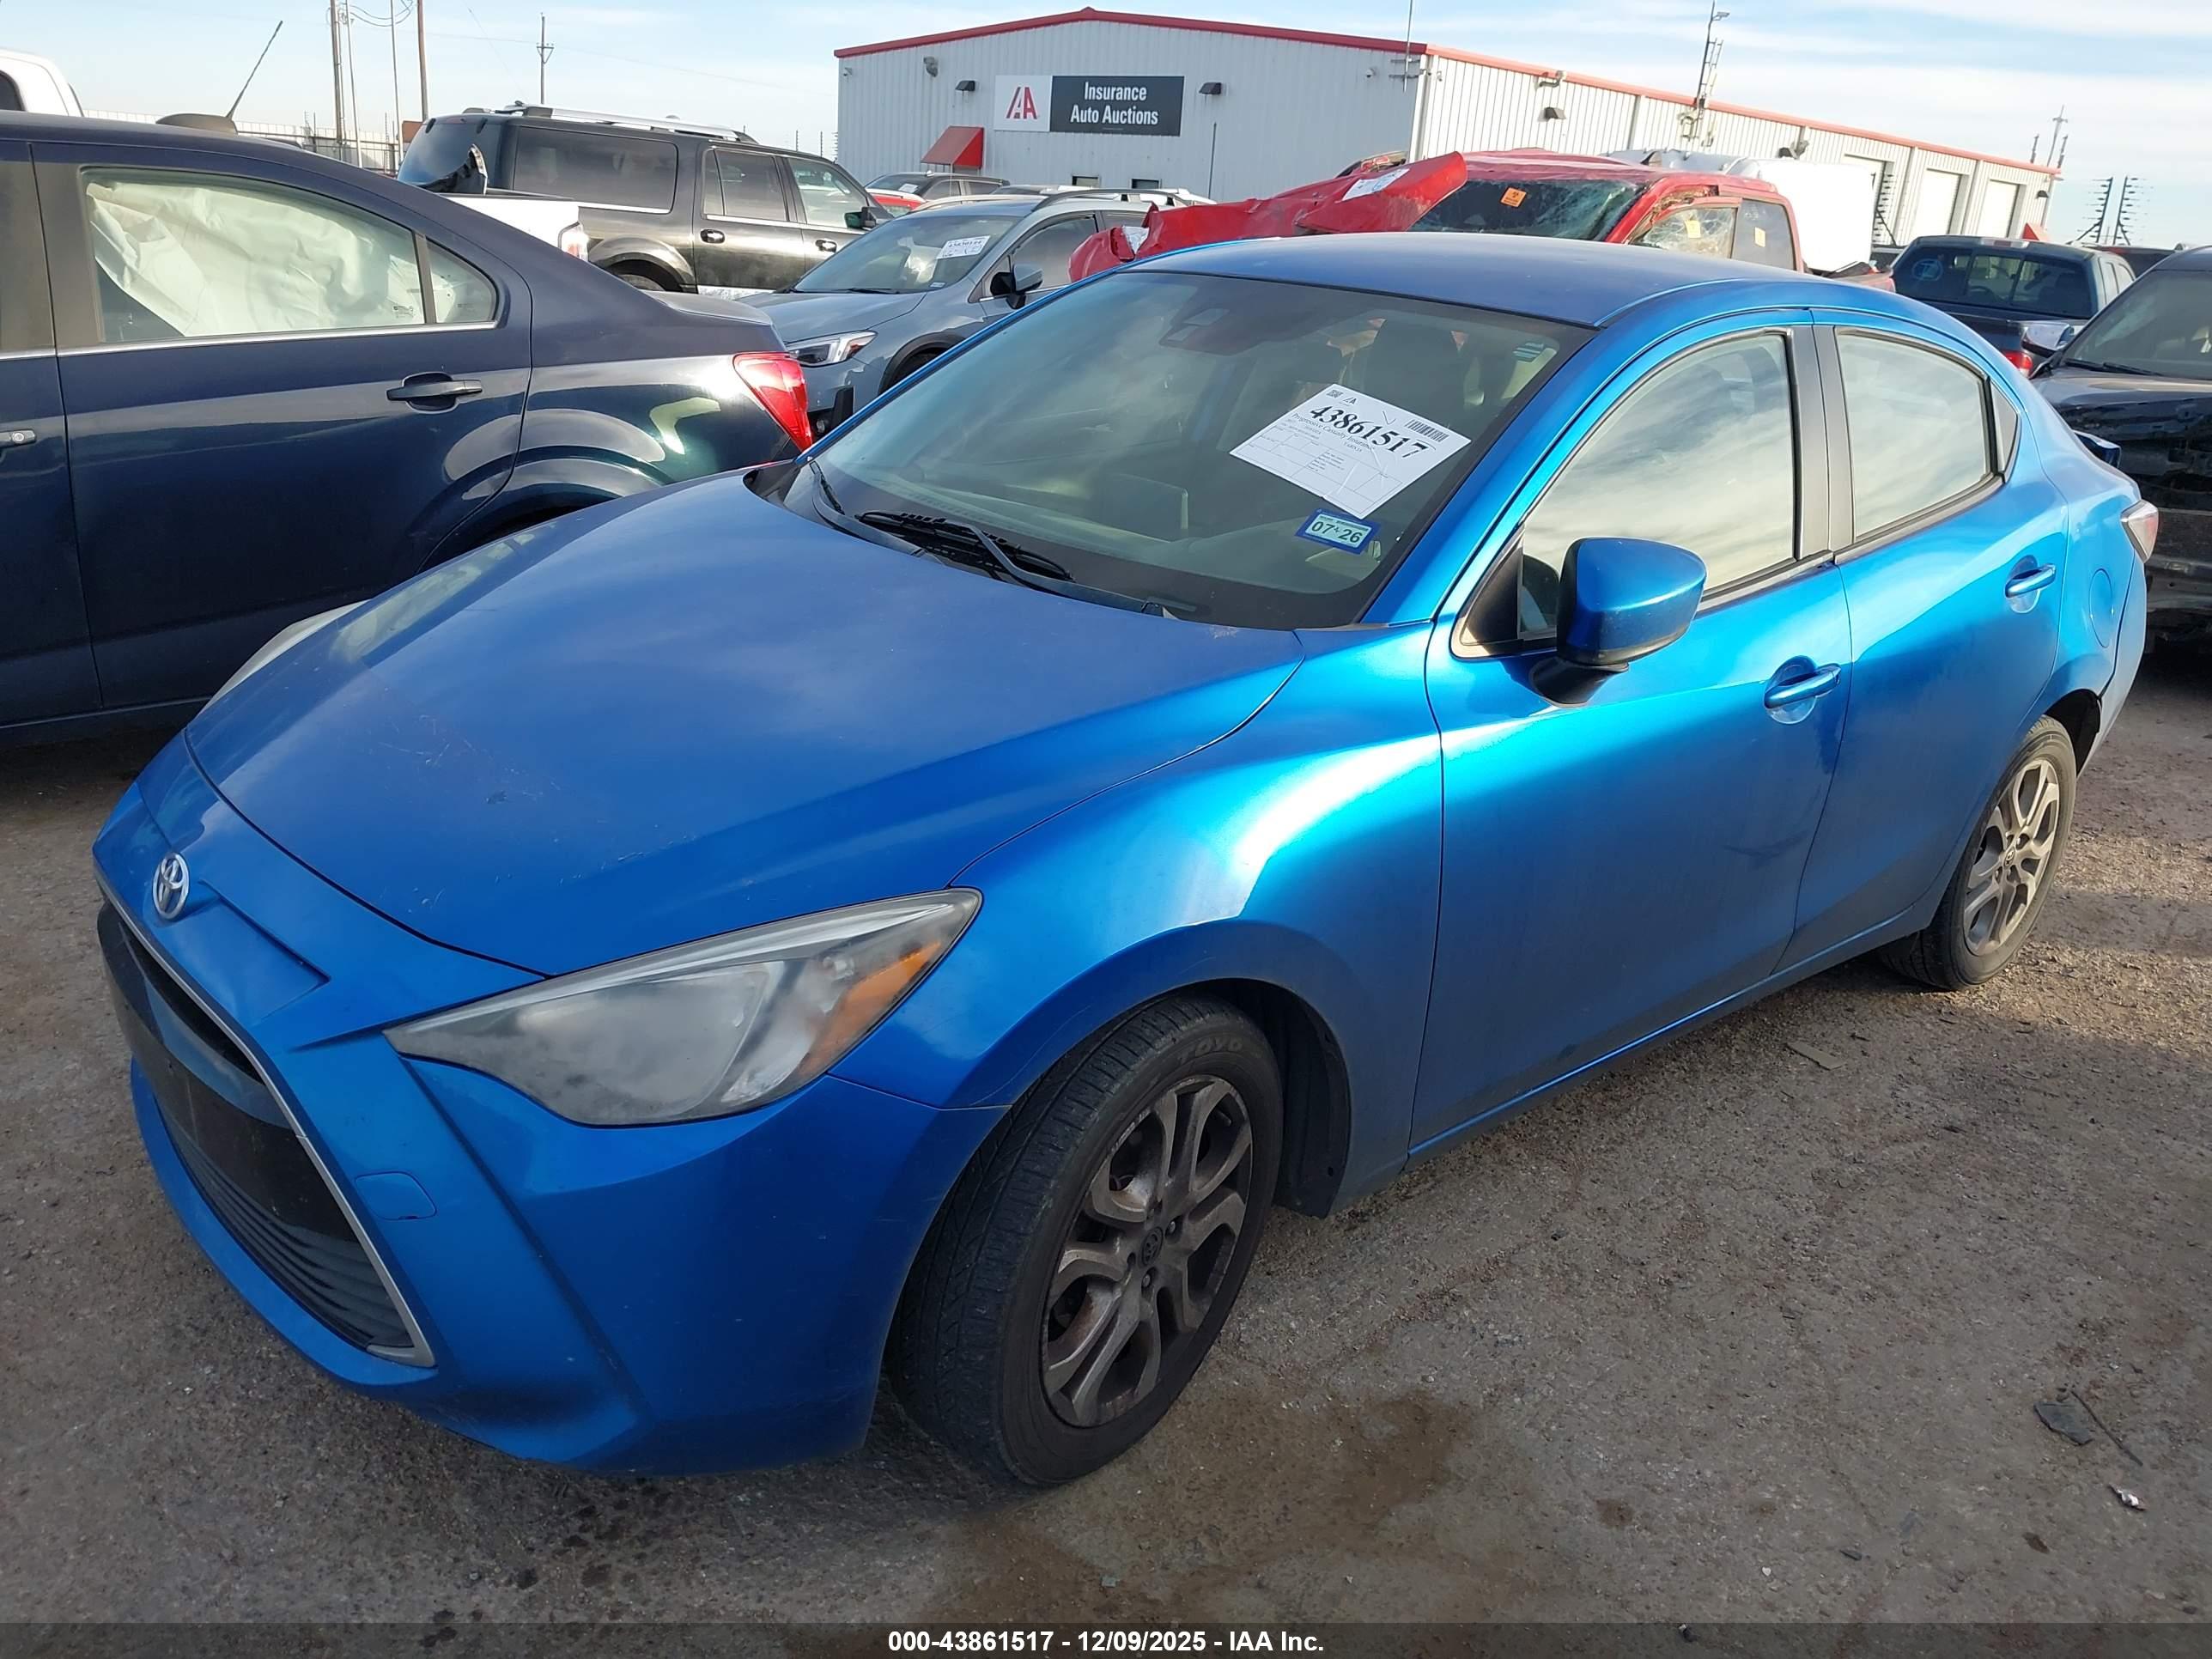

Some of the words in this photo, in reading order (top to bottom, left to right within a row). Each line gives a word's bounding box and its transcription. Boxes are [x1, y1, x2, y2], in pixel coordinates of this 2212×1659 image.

[1085, 82, 1147, 101] Insurance
[1070, 104, 1099, 124] Auto
[1102, 105, 1158, 125] Auctions
[1310, 405, 1428, 459] 43861517
[1311, 521, 1335, 534] 07
[1337, 528, 1363, 543] 26
